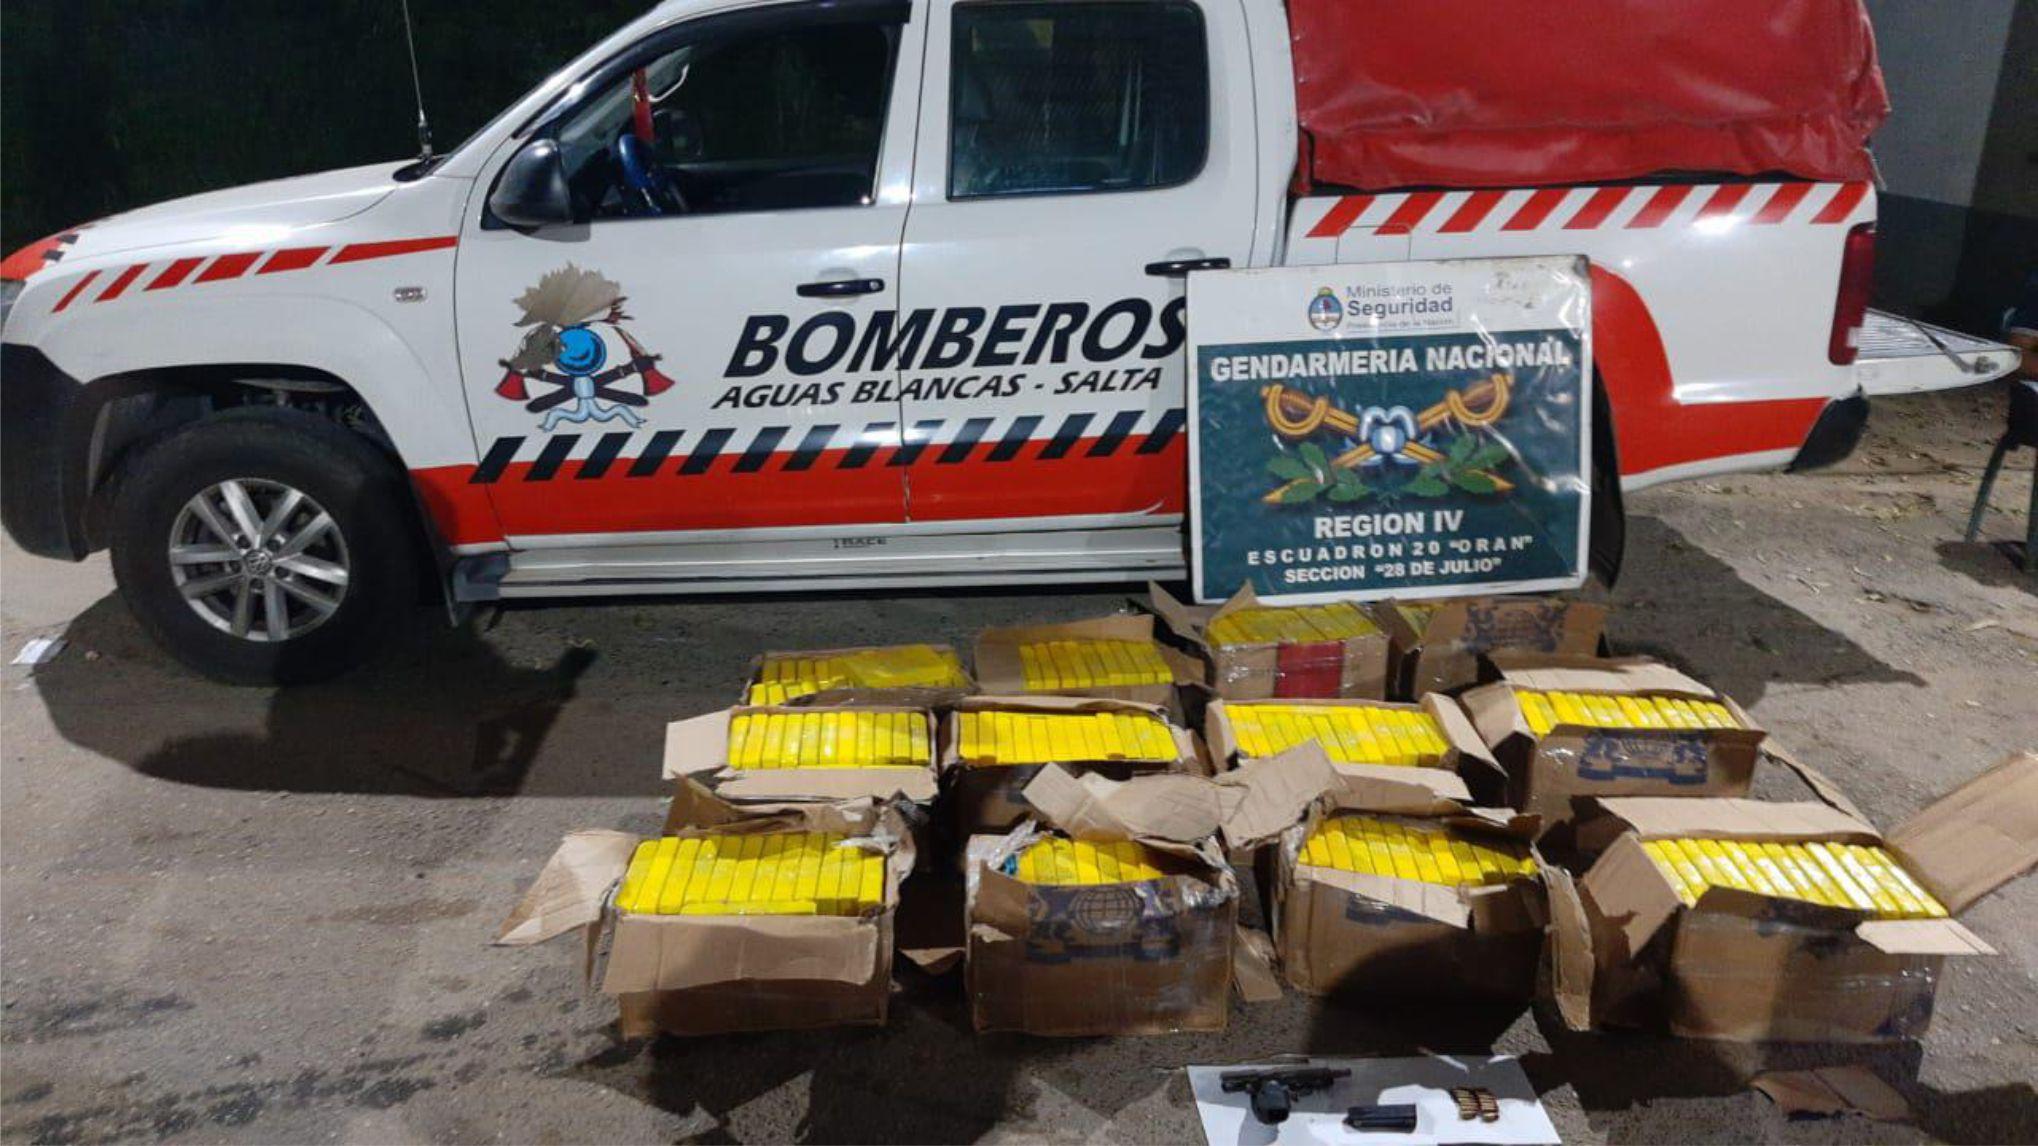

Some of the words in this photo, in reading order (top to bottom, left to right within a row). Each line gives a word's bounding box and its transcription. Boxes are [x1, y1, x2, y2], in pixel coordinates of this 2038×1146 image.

[1347, 283, 1426, 298] Miniserio
[1432, 282, 1452, 295] de
[1347, 296, 1453, 318] Seguridad
[723, 296, 1186, 377] BOMBEROS
[1210, 349, 1419, 382] GENDARMERIA
[1426, 341, 1573, 371] NACIONAL
[711, 380, 845, 409] AGUAS
[850, 373, 1026, 404] BLANCAS
[1053, 367, 1162, 395] SALTA
[1314, 512, 1425, 539] REGION
[1434, 510, 1463, 532] IV
[1284, 566, 1365, 584] SECCION
[1410, 560, 1435, 576] DE
